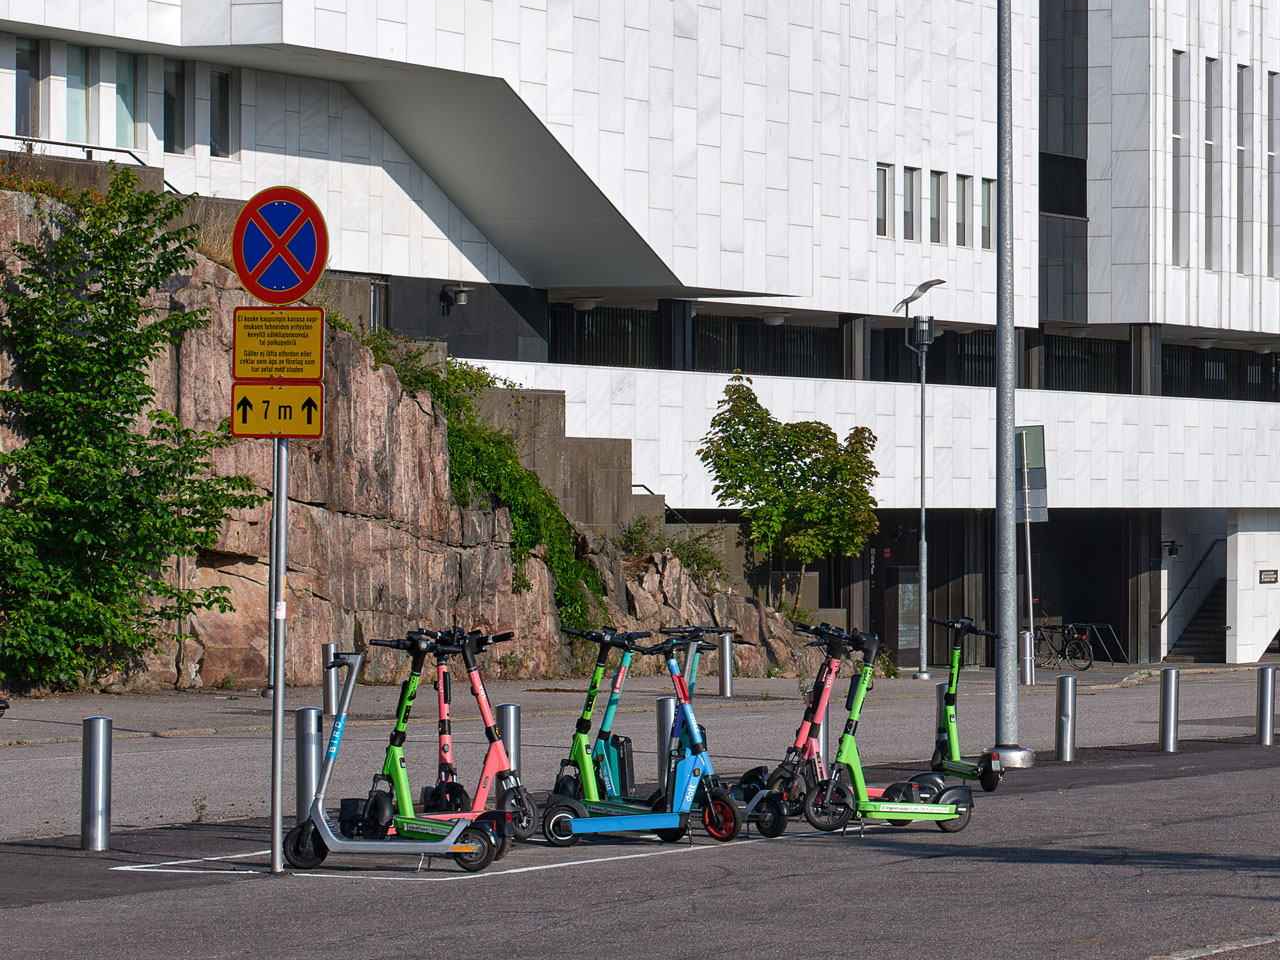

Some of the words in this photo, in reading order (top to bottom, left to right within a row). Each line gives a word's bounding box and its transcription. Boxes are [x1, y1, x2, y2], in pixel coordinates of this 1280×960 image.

[260, 315, 286, 324] kaupungin
[287, 315, 305, 323] kanssa
[290, 323, 313, 331] yritysten
[247, 331, 266, 339] kevyitä
[260, 350, 265, 358] ej
[240, 358, 256, 366] cyklar
[268, 358, 278, 366] ägs
[285, 358, 304, 366] företag
[261, 400, 271, 420] 7
[277, 404, 293, 420] m
[689, 713, 699, 733] dott
[328, 721, 341, 753] BIRD
[603, 776, 611, 790] dott
[685, 784, 696, 802] dott
